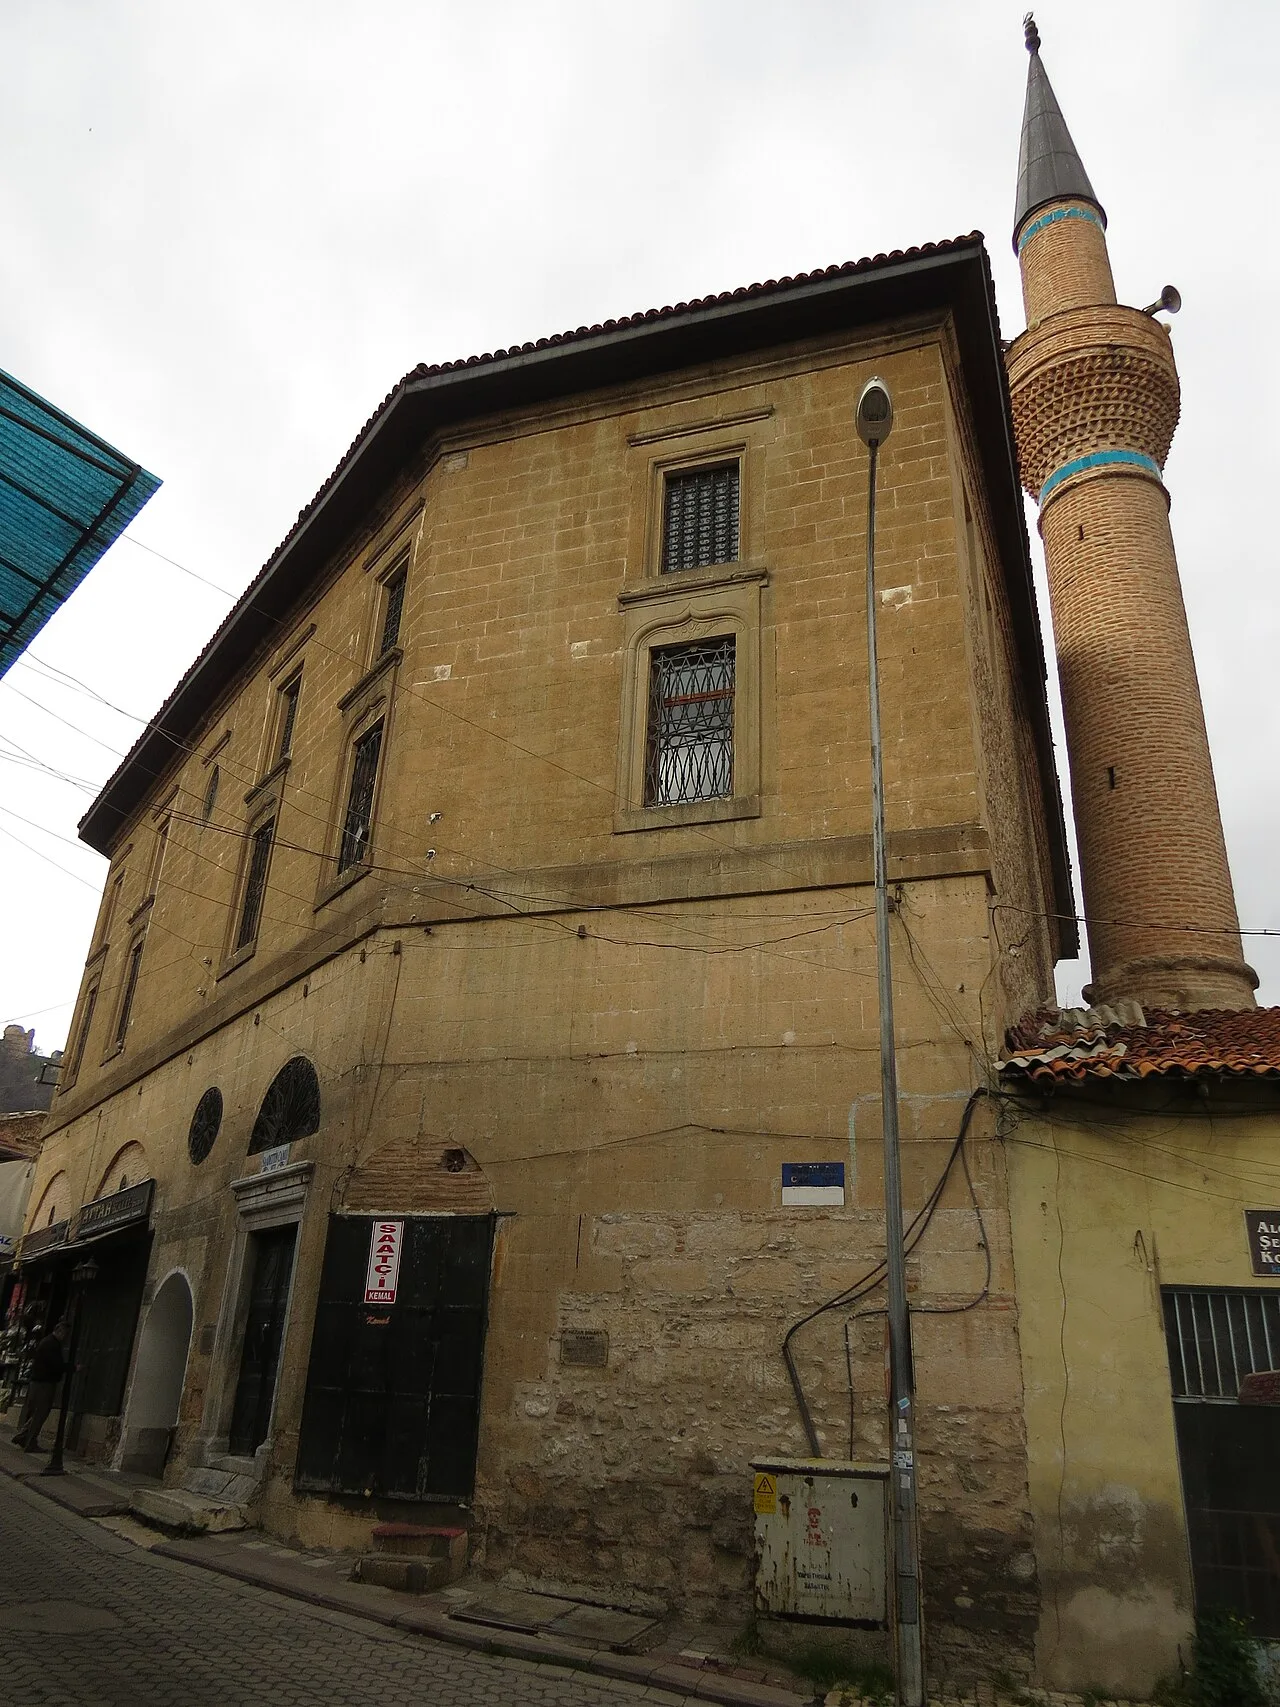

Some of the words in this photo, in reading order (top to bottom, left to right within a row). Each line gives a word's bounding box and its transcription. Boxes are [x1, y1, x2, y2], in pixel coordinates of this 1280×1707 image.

[1257, 1221, 1280, 1234] AL
[374, 1224, 398, 1288] SAATÇİ
[368, 1291, 392, 1301] KEMAL
